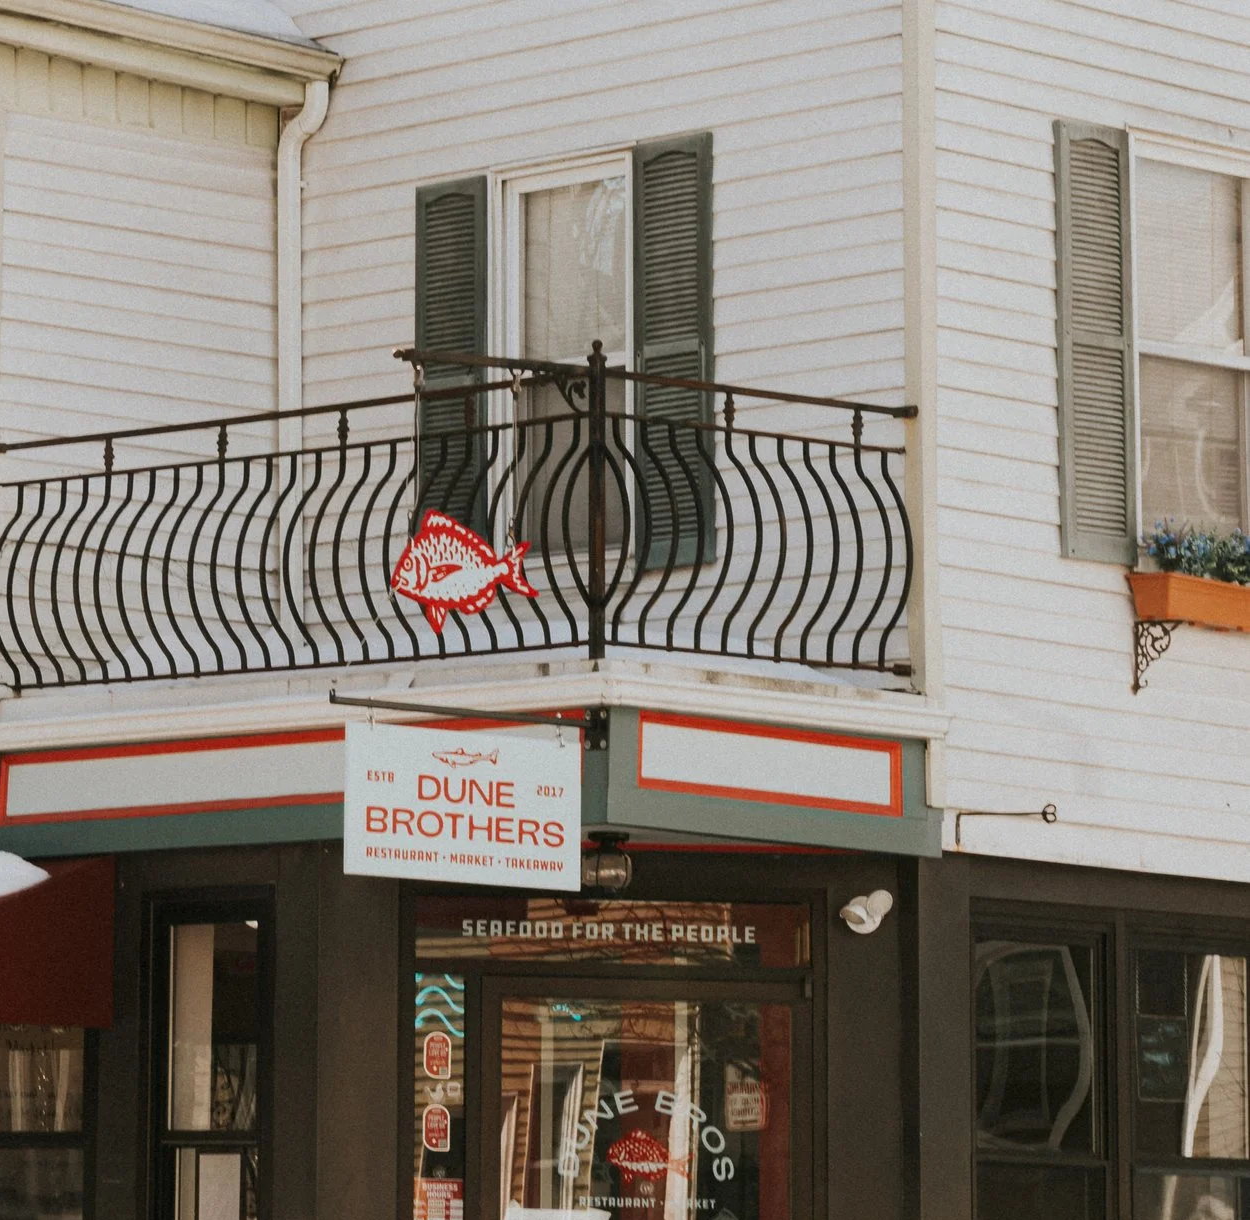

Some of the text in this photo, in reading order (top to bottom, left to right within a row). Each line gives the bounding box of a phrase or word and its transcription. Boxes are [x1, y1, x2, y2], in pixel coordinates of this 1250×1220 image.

[367, 769, 395, 783] ESTB
[417, 774, 515, 808] DUNE
[536, 785, 564, 798] 2017
[366, 806, 565, 848] BROTHERS
[366, 846, 564, 872] RESTAURANT MARKET TAKEAWAY
[462, 919, 756, 944] SEAFOOD FOR THE PEOPLE
[558, 1089, 735, 1182] DUNE BROS
[421, 1182, 459, 1192] BUSINESS
[579, 1195, 656, 1209] RESTAURANT
